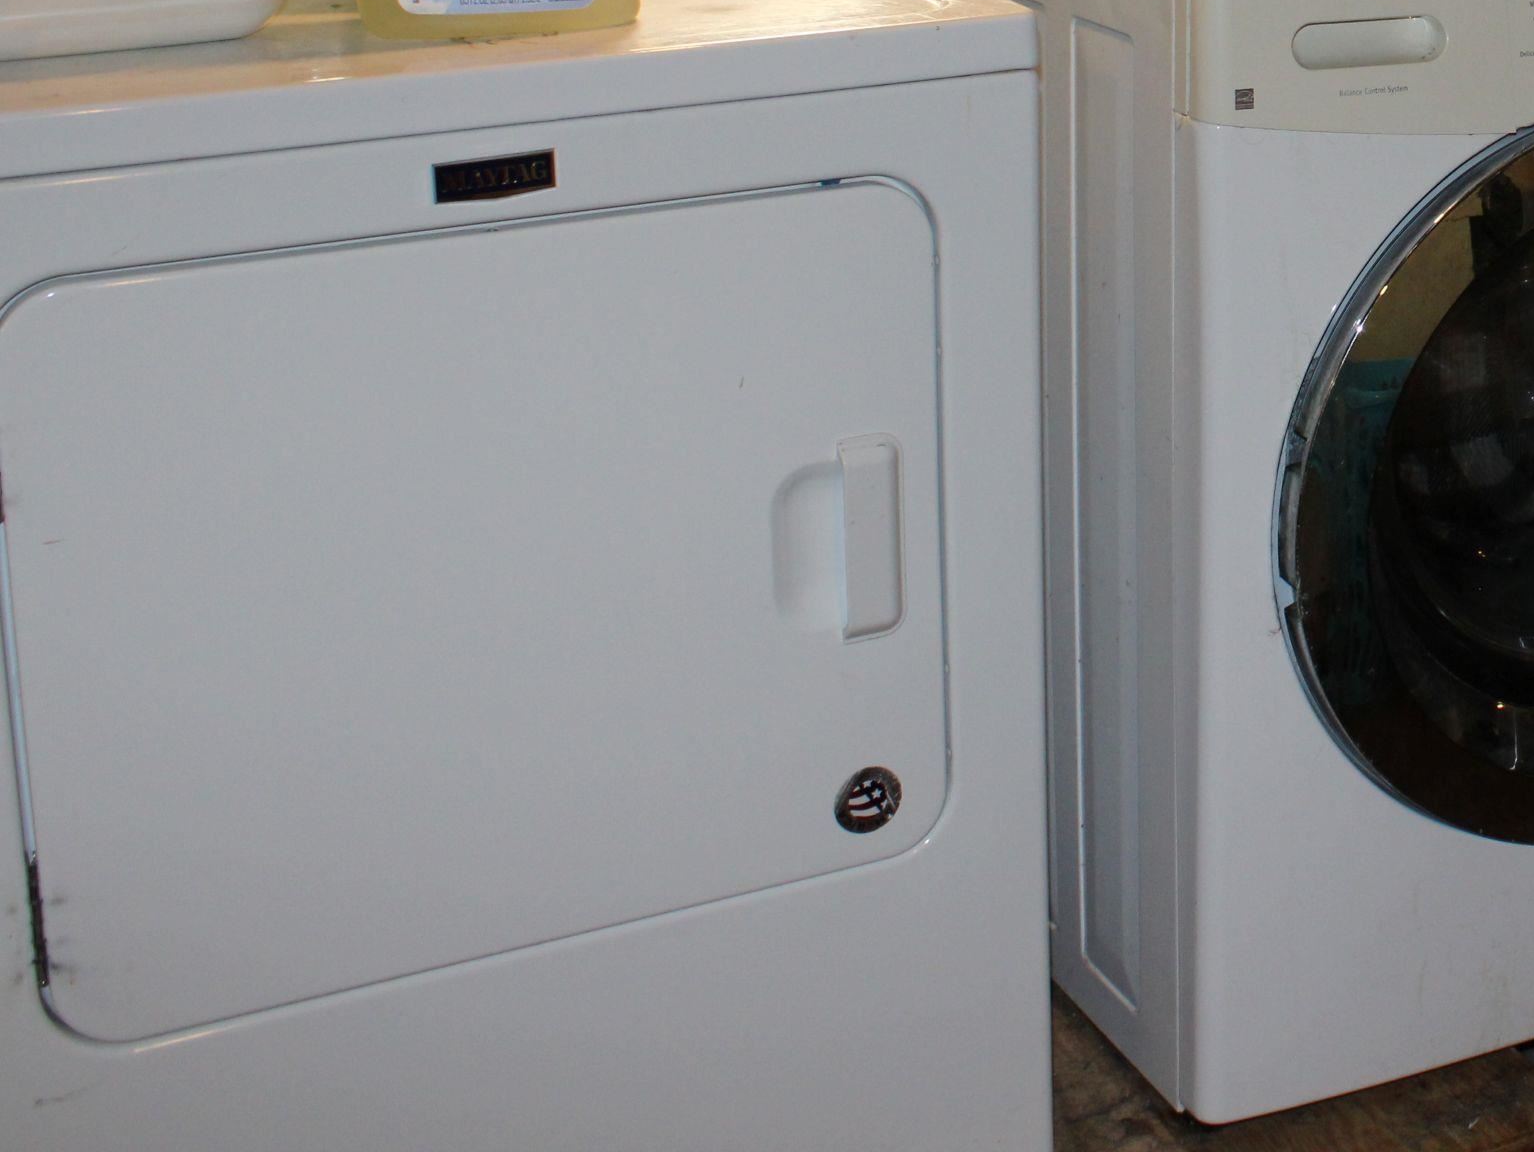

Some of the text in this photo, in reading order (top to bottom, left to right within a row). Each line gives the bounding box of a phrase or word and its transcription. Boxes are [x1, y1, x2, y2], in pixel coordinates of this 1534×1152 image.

[1339, 85, 1408, 97] Balance Control System
[441, 160, 548, 193] MAYTAG
